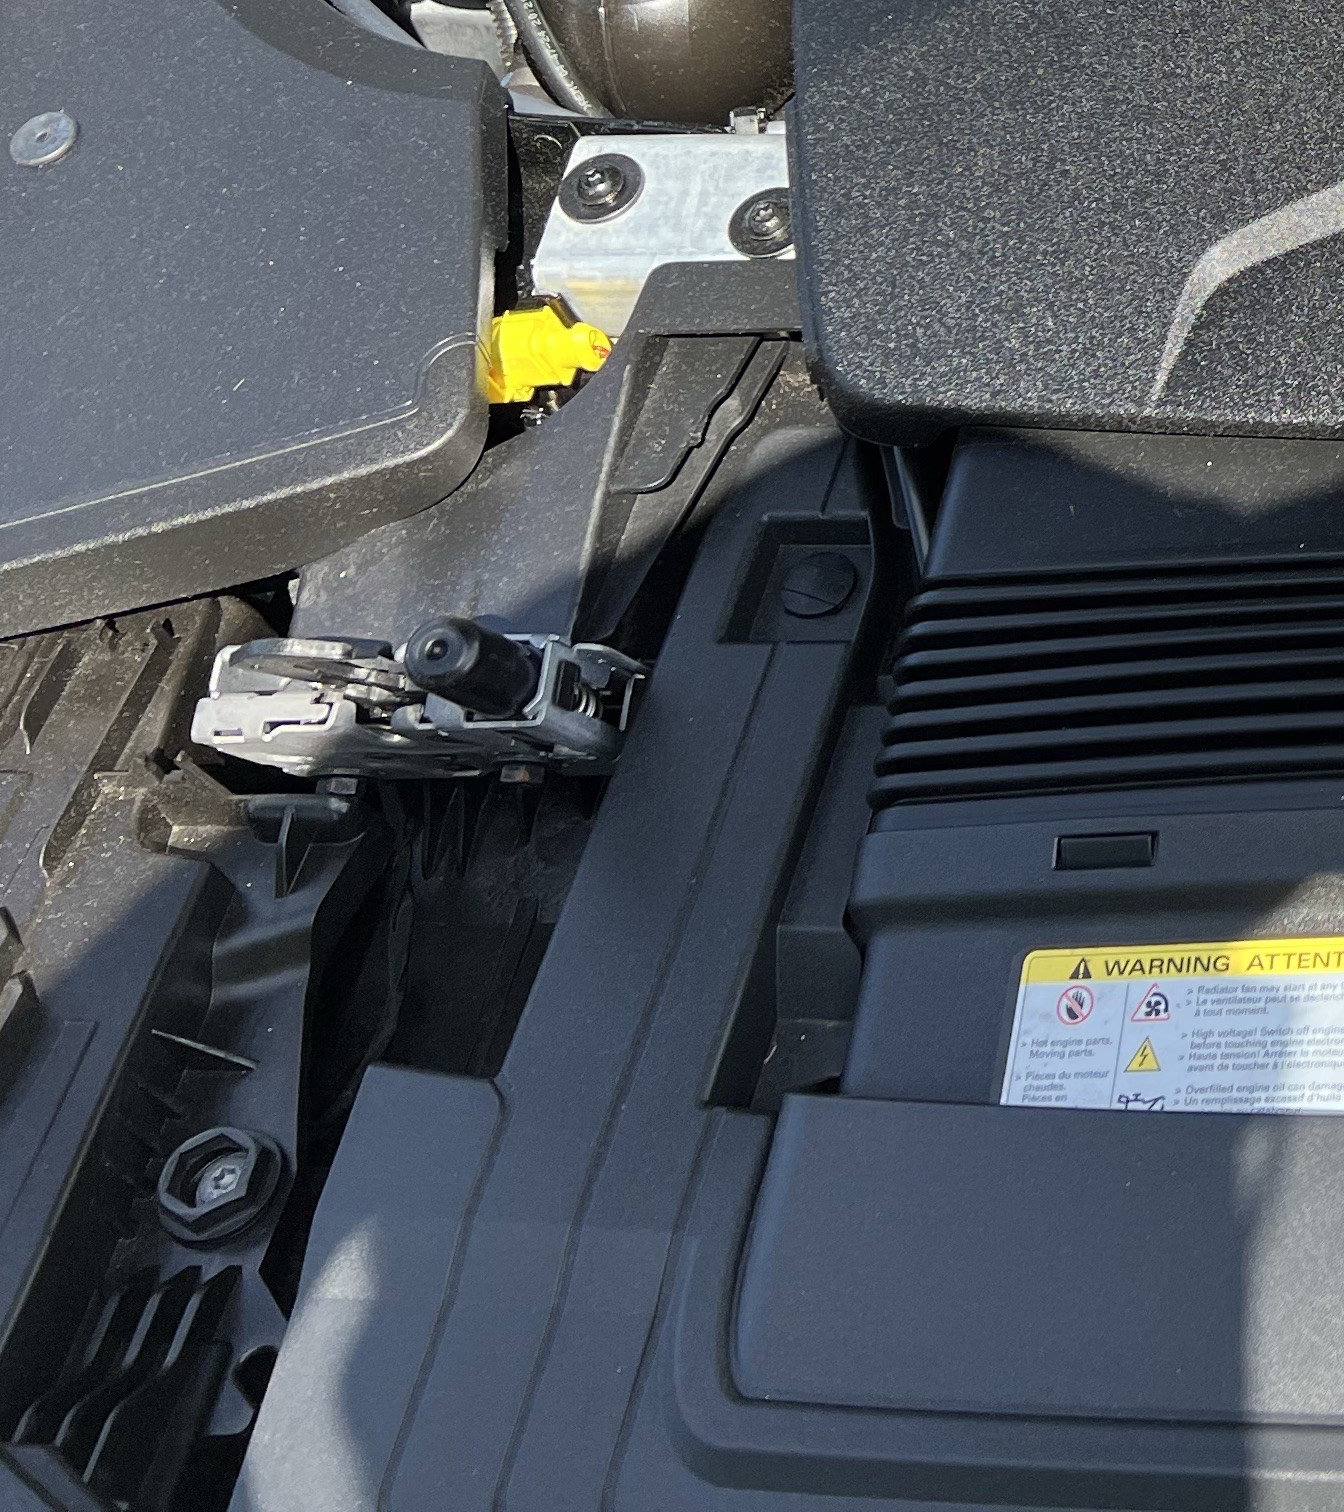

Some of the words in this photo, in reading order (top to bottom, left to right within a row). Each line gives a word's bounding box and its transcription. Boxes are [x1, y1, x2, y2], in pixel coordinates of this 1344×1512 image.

[1103, 955, 1230, 975] WARNING
[1197, 985, 1238, 994] Radiator
[1241, 984, 1256, 992] fan
[1259, 985, 1279, 993] may
[1308, 982, 1317, 990] at
[1320, 983, 1337, 991] any
[1196, 996, 1207, 1005] Le
[1210, 996, 1261, 1004] ventilateur
[1265, 995, 1286, 1004] peut
[1203, 1008, 1222, 1016] tout
[1191, 1029, 1214, 1040] High
[1260, 1026, 1293, 1035] Switch
[1296, 1024, 1309, 1034] off
[1312, 1025, 1344, 1035] engine
[1030, 1039, 1048, 1047] Hot
[1050, 1039, 1082, 1048] engine
[1190, 1040, 1221, 1049] before
[1224, 1039, 1267, 1048] touching
[1270, 1038, 1303, 1047] engine
[1029, 1049, 1065, 1059] Moving
[1188, 1051, 1217, 1060] Haute
[1187, 1063, 1214, 1071] avant
[1216, 1062, 1229, 1071] de
[1231, 1061, 1269, 1070] toucher
[1058, 1071, 1071, 1079] du
[1073, 1070, 1108, 1079] moteur
[1185, 1083, 1233, 1094] Overfilled
[1235, 1083, 1269, 1094] engine
[1272, 1082, 1285, 1091] oil
[1287, 1083, 1305, 1091] can
[1184, 1096, 1198, 1105] Un
[1200, 1094, 1261, 1107] remplissage
[1264, 1092, 1304, 1103] excessif
